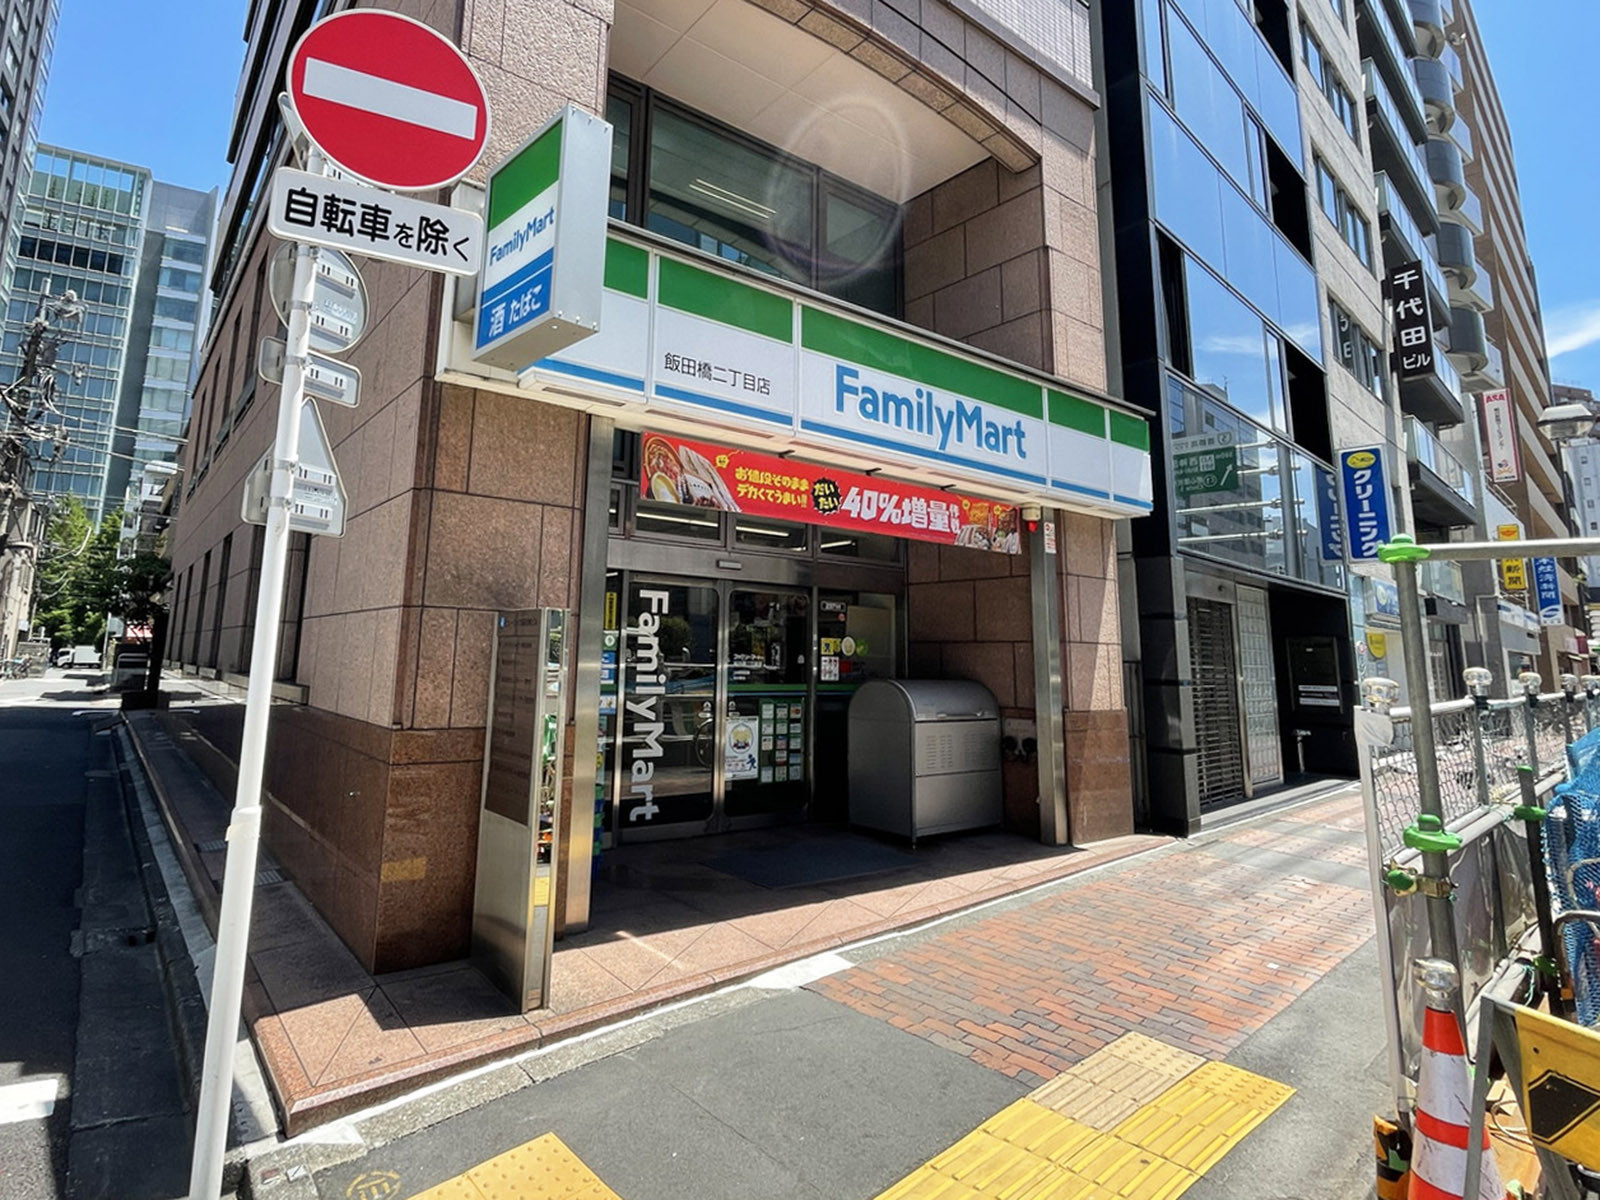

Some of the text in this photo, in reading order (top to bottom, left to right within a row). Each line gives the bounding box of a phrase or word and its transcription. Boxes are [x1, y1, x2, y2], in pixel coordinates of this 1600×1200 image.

[284, 187, 470, 262] 自転車を除く
[489, 206, 555, 266] FamilyMart
[489, 284, 543, 337] 酒 たばこ
[1393, 269, 1431, 370] 千代田ビル
[664, 352, 771, 396] 飯田橋二丁目店
[834, 363, 1028, 460] FamilyMart
[735, 466, 810, 492] お値段そのまま
[814, 483, 835, 496] だい
[818, 497, 839, 510] たい
[841, 486, 951, 533] 40%増量
[1353, 469, 1383, 557] クリーニング
[1505, 558, 1522, 586] 新聞
[626, 589, 670, 822] FamilyMart
